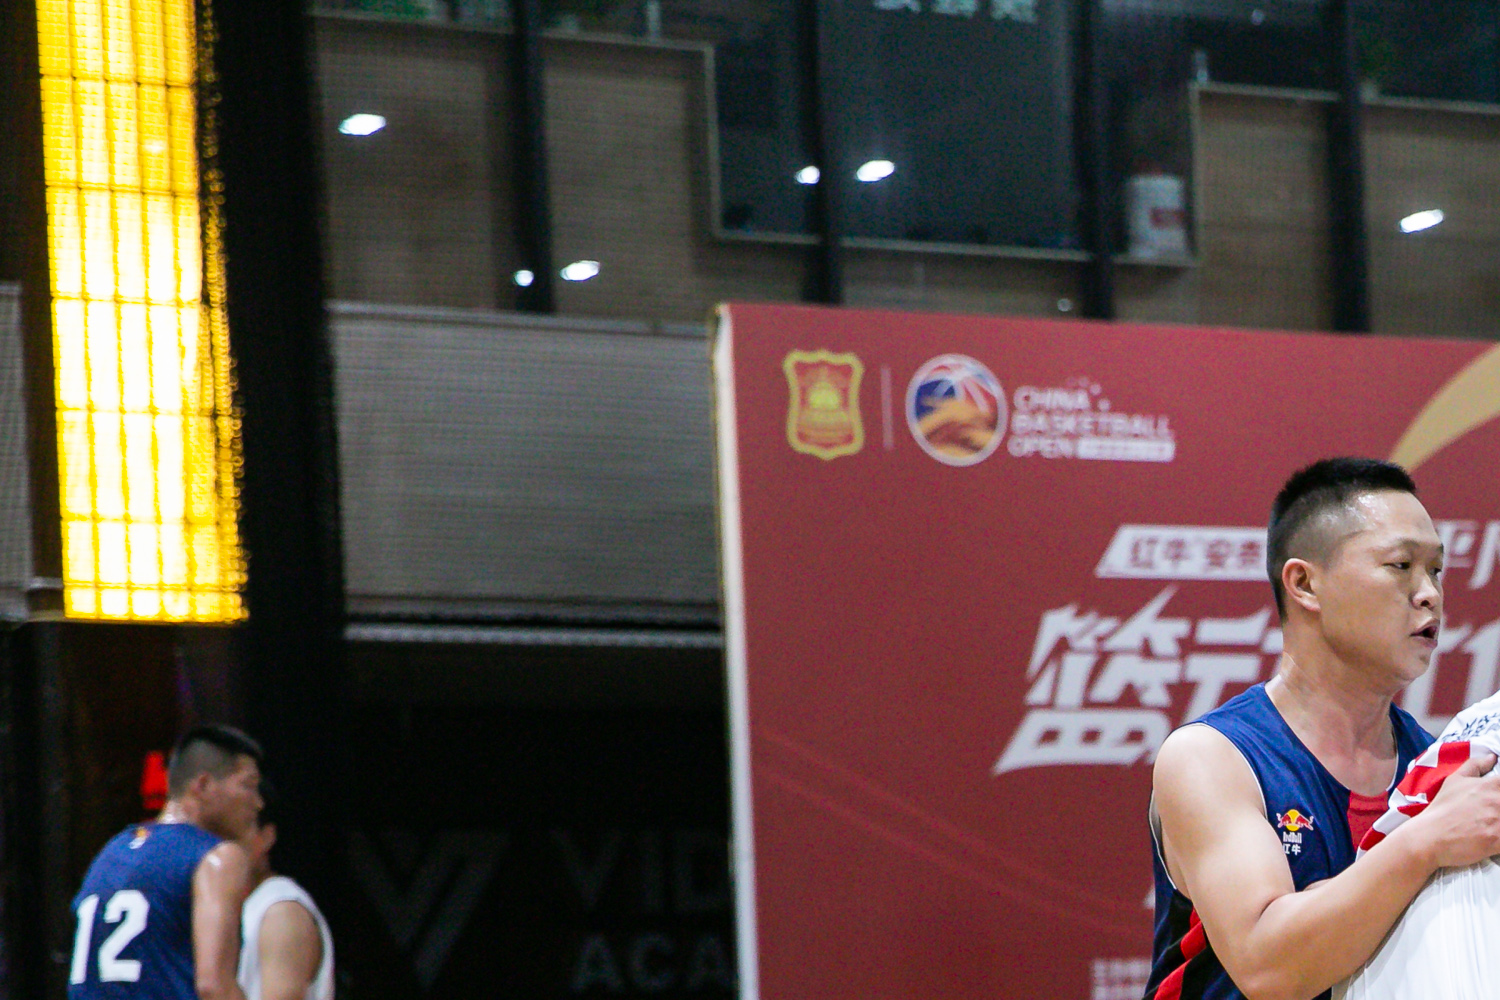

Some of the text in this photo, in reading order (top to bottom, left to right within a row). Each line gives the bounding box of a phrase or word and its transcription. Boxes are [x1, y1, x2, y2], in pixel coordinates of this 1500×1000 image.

[1013, 386, 1091, 411] CHINA
[1011, 412, 1170, 438] BASKETBALL
[1006, 435, 1075, 459] OPEN
[69, 889, 150, 985] 12
